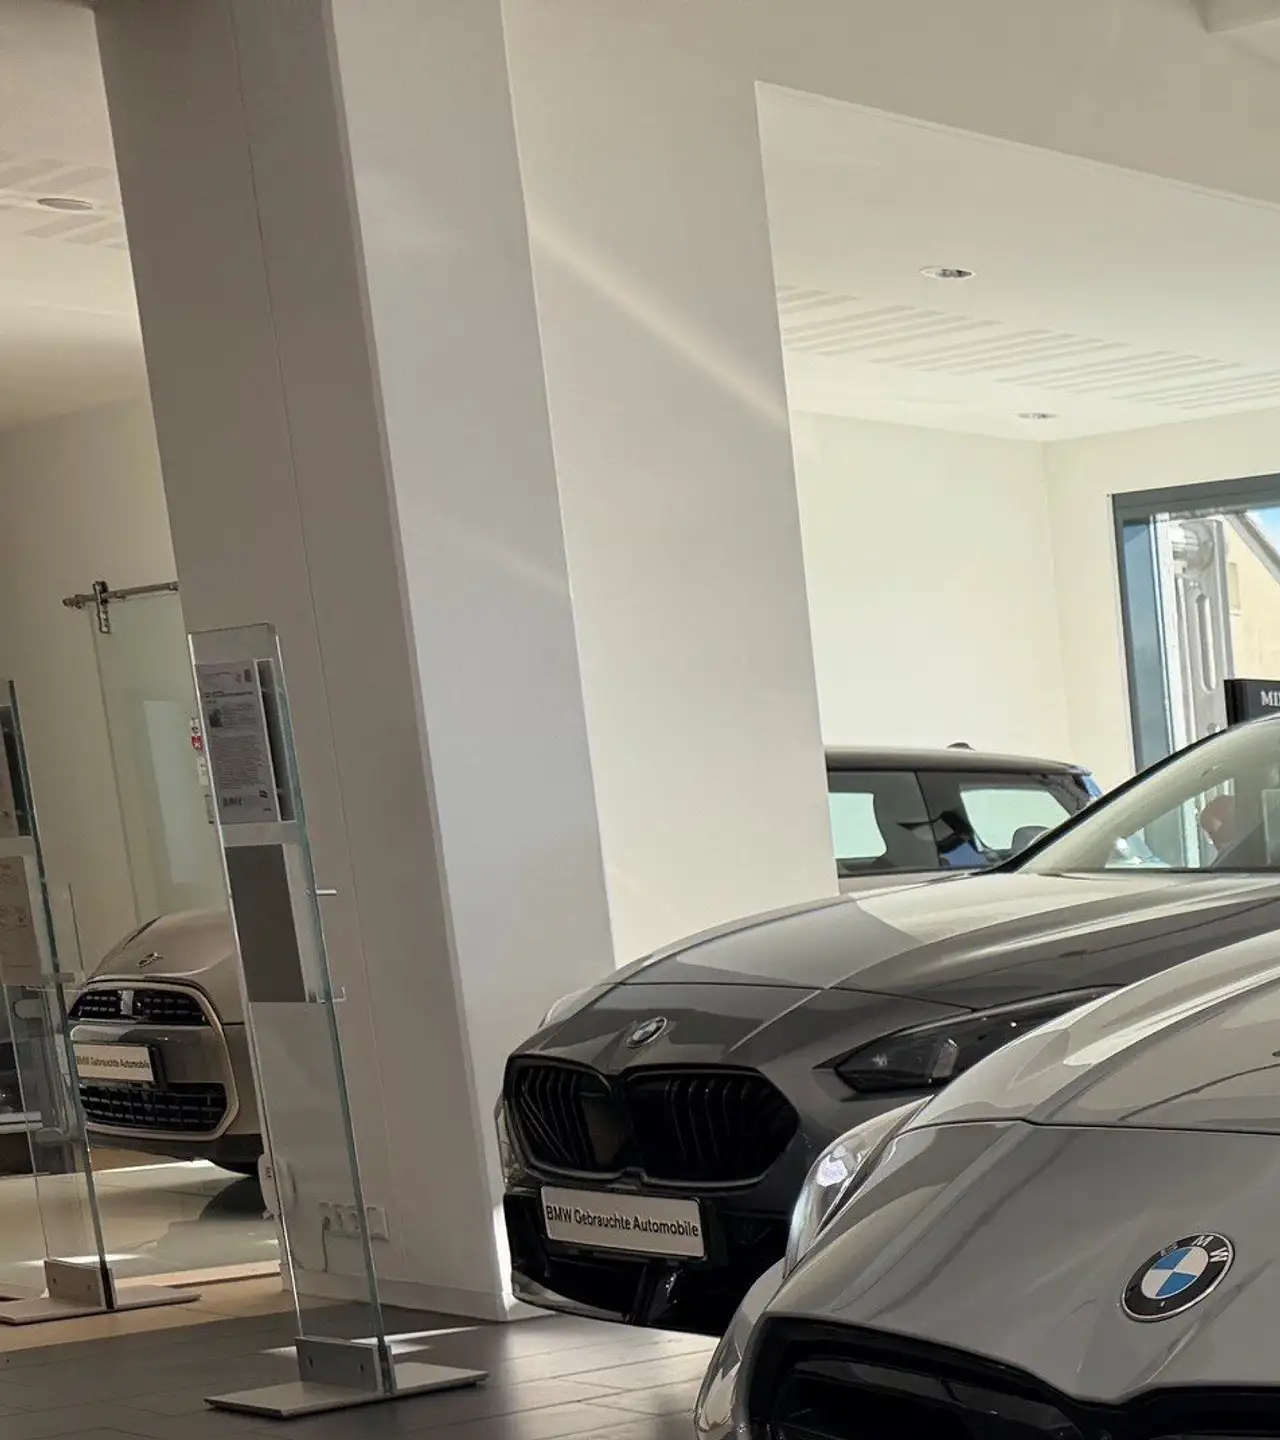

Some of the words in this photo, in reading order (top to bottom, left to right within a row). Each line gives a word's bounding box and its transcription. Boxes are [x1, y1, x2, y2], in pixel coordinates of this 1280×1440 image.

[545, 1205, 572, 1224] BMW
[574, 1209, 631, 1230] Gebrauchte
[632, 1215, 699, 1237] Automobile
